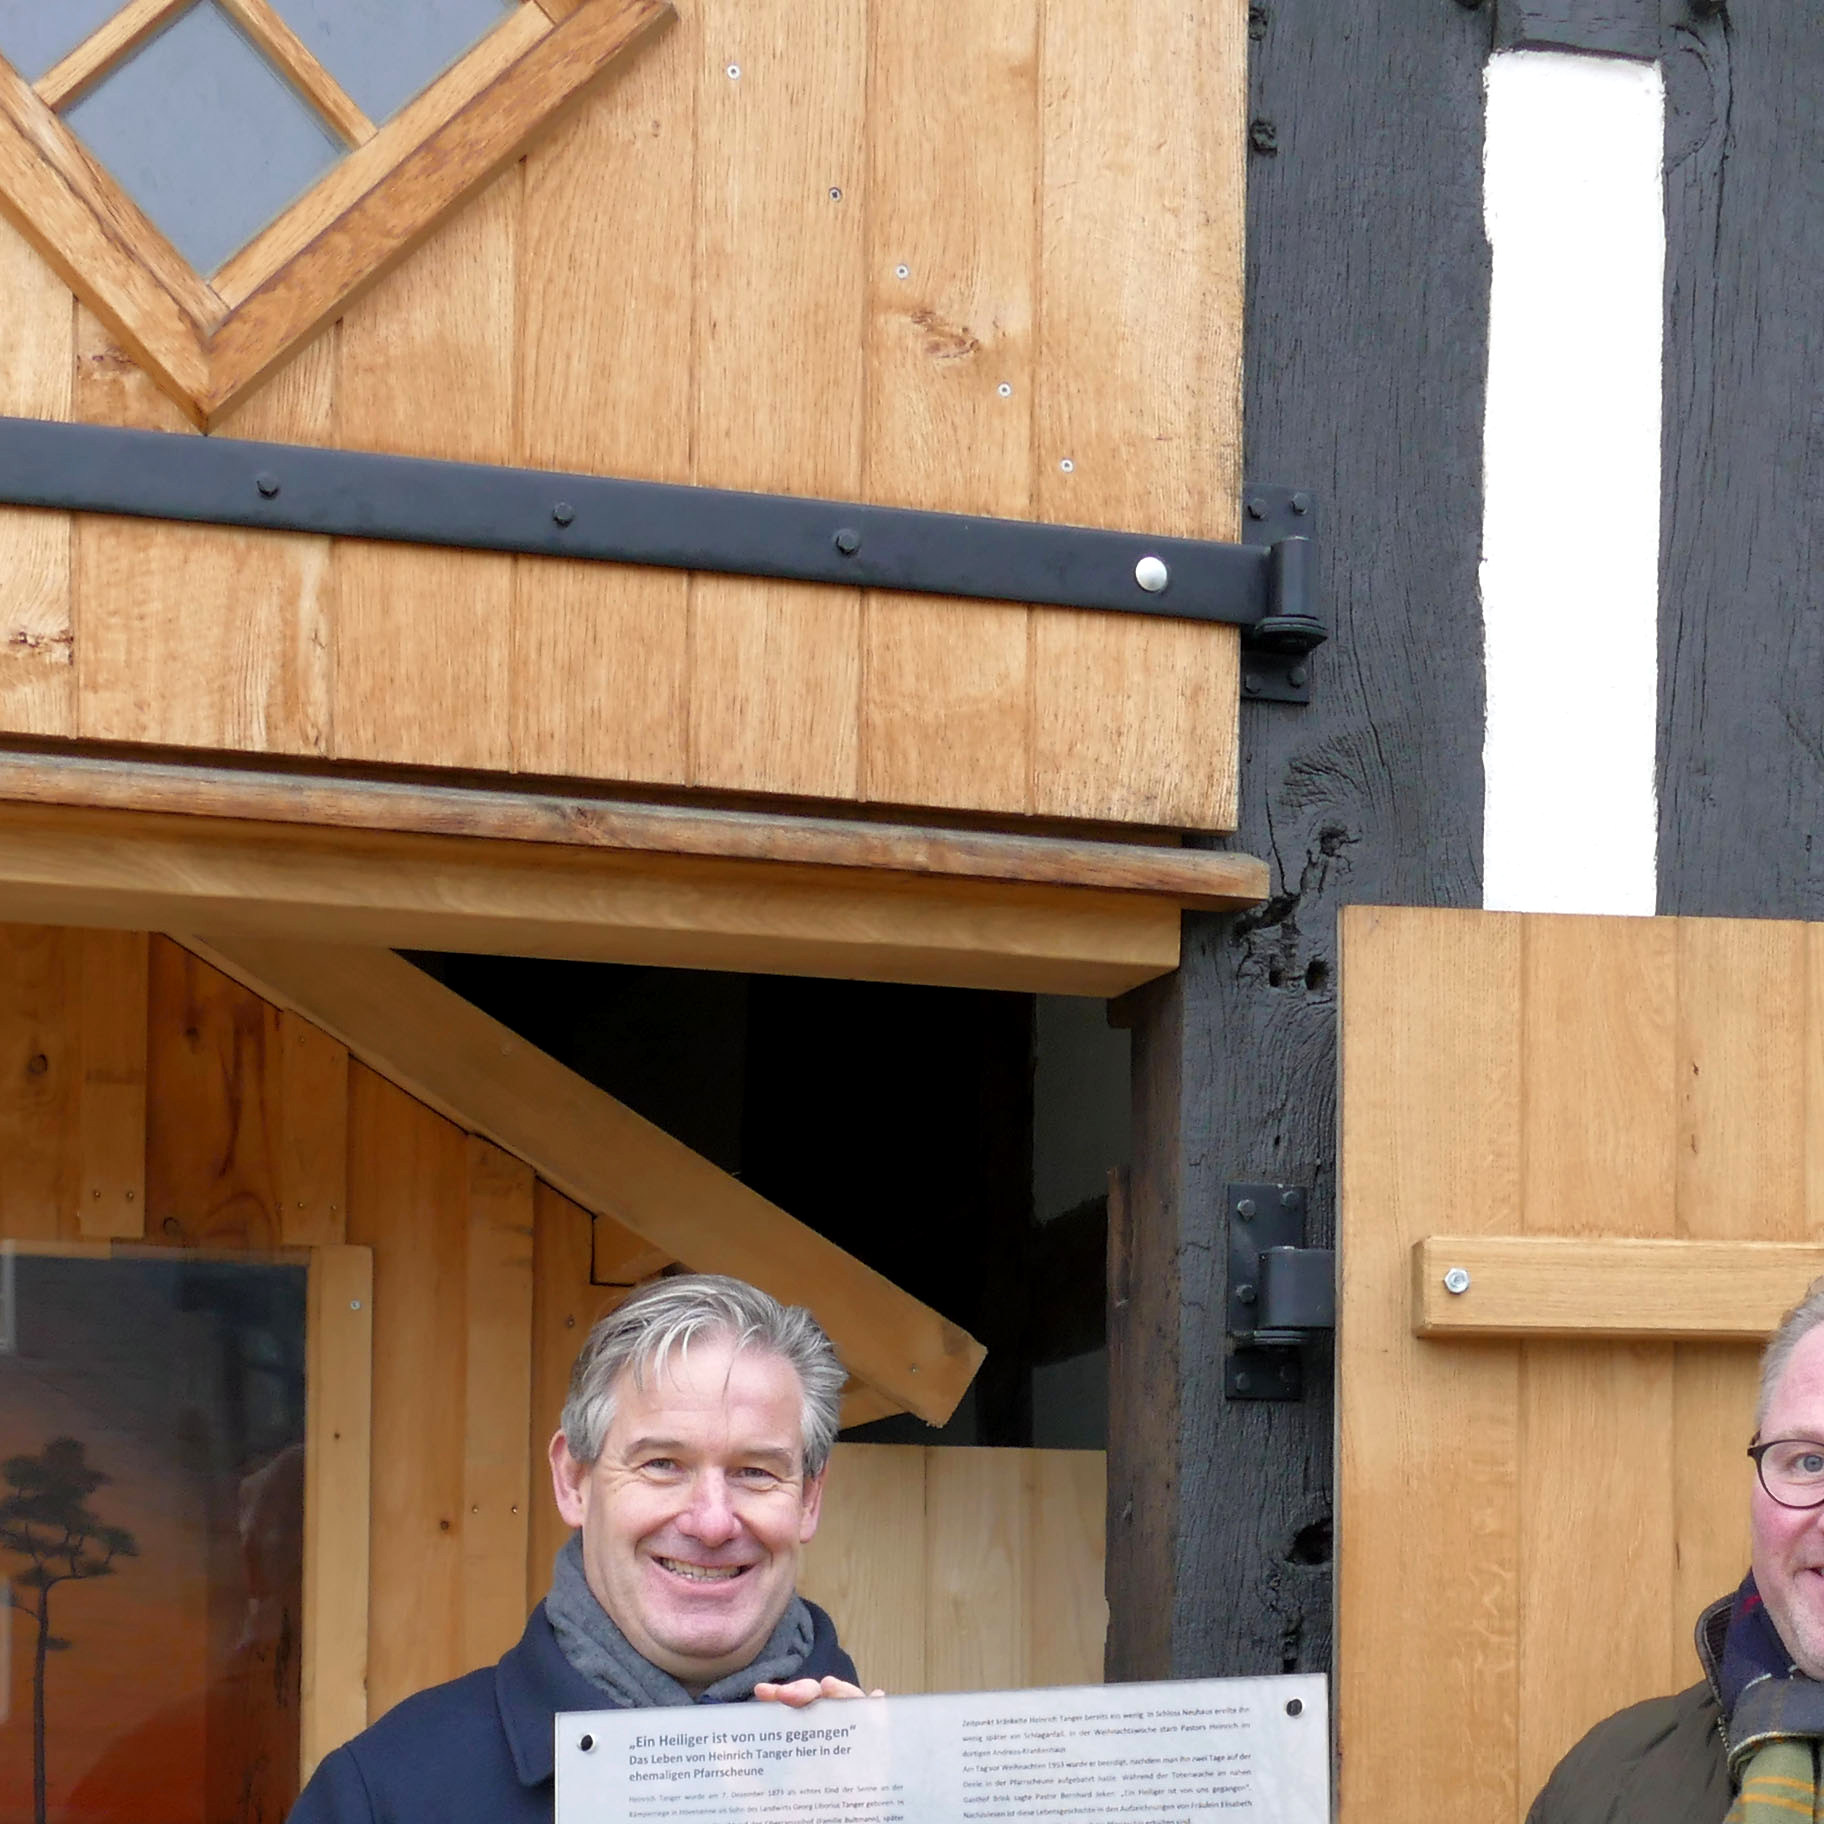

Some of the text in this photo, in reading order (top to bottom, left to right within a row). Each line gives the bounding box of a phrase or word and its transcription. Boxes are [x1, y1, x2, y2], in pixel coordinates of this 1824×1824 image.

[659, 1732, 709, 1749] Heiliger
[712, 1731, 727, 1743] ist
[730, 1733, 755, 1743] von
[759, 1731, 782, 1741] uns
[629, 1744, 851, 1765] Das Leben von Heinrich Tanger hier in der
[1191, 1754, 1207, 1762] zwei
[1209, 1754, 1225, 1762] Tage
[628, 1765, 764, 1783] ehemaligen Pfarrscheune
